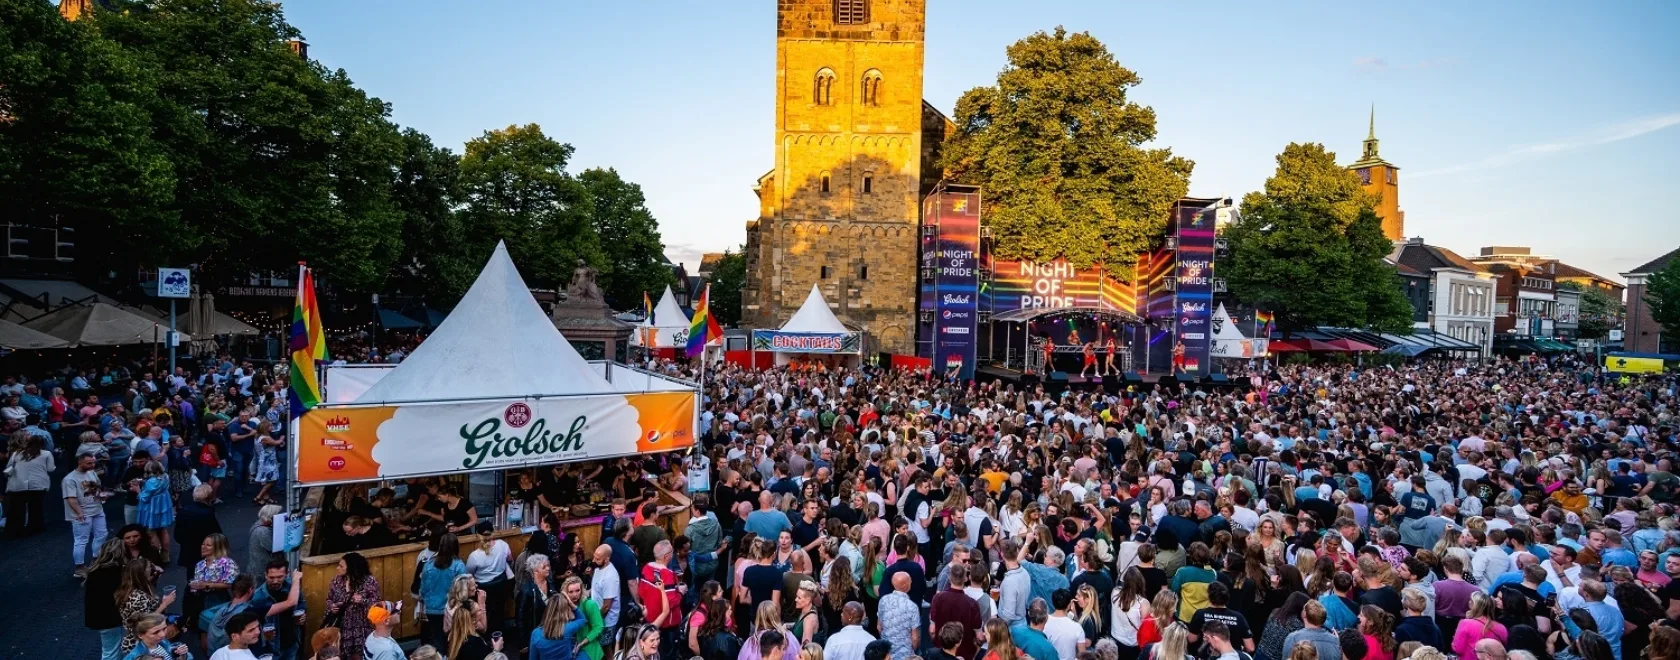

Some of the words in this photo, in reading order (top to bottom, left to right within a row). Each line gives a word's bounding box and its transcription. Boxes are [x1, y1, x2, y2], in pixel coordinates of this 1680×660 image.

[943, 250, 973, 259] NIGHT
[951, 259, 964, 267] OF
[1182, 260, 1208, 269] NIGHT
[943, 268, 972, 277] PRIDE
[1021, 261, 1075, 278] NIGHT
[1188, 268, 1201, 276] OF
[1182, 276, 1207, 285] PRIDE
[1035, 278, 1061, 295] OF
[943, 293, 970, 305] Grolsch
[1021, 295, 1074, 309] PRIDE
[773, 335, 842, 350] COCKTAILS
[460, 415, 587, 469] Grolsch
